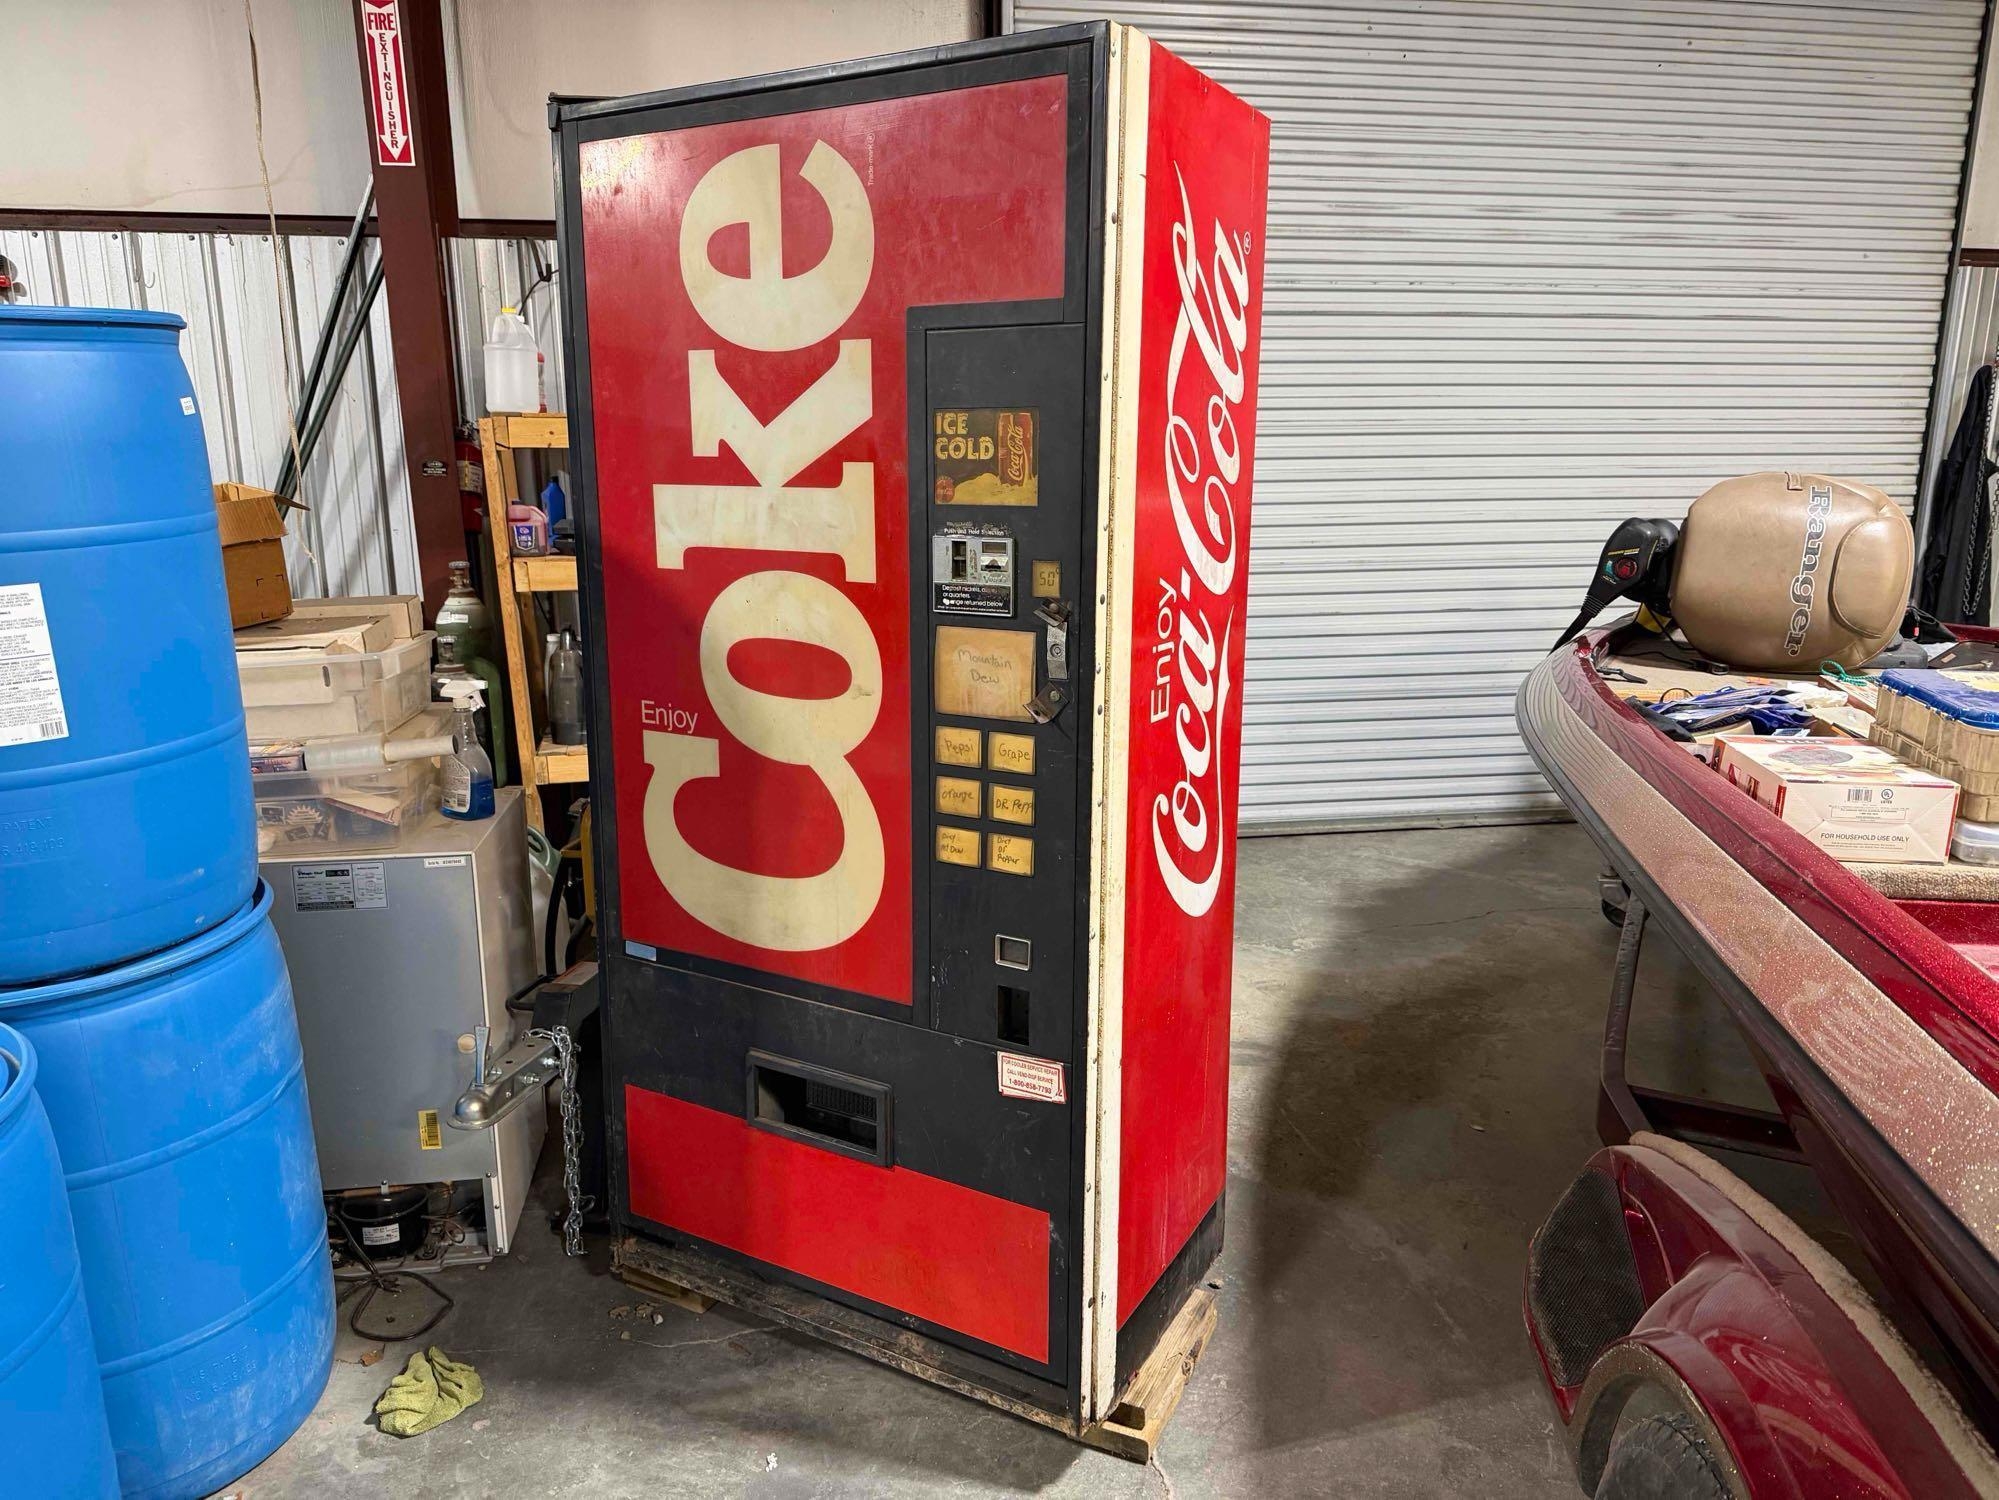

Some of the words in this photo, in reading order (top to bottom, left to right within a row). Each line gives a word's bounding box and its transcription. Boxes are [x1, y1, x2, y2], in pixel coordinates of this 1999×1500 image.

[367, 12, 396, 31] FIRE
[378, 32, 399, 149] EXTINGUISHER
[935, 412, 968, 435] ICE
[935, 436, 995, 460] COLD
[643, 138, 885, 952] Coke
[1152, 159, 1250, 918] Coca-Cola
[1784, 486, 1832, 657] Ranger
[964, 599, 986, 607] returned
[958, 648, 1013, 670] Mountain
[1150, 577, 1177, 724] Enjoy
[969, 668, 999, 685] Dew
[641, 699, 698, 733] Enjoy
[944, 738, 974, 756] Pepsi
[998, 743, 1031, 762] Grape
[1836, 833, 1876, 841] HOUSEHOLD
[1007, 1068, 1017, 1076] CALL
[1037, 1074, 1053, 1084] SERVICE
[1011, 1060, 1027, 1070] COOLER
[1027, 1064, 1043, 1073] SERVICE
[1043, 1068, 1058, 1076] REPAIR
